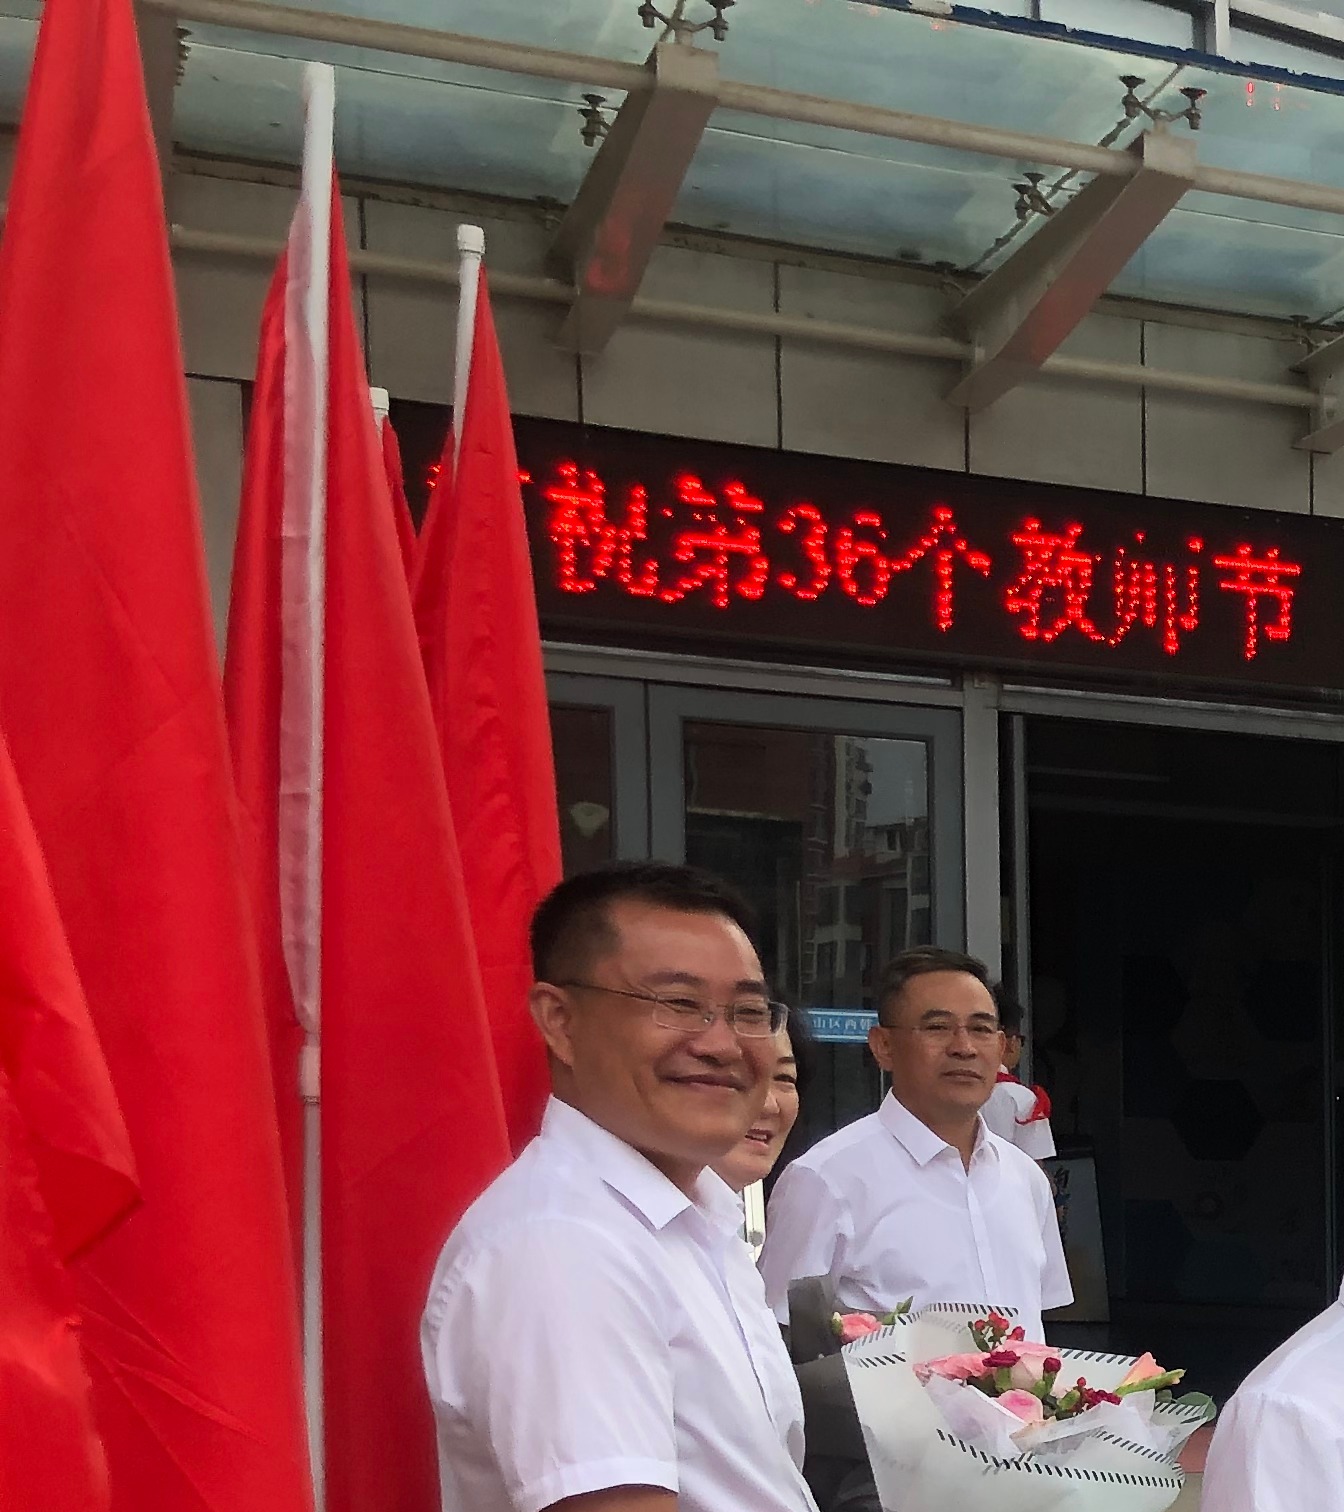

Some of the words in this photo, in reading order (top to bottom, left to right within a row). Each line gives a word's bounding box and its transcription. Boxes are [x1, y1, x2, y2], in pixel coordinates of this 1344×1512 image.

[425, 458, 1302, 661] 祝第36个教师节
